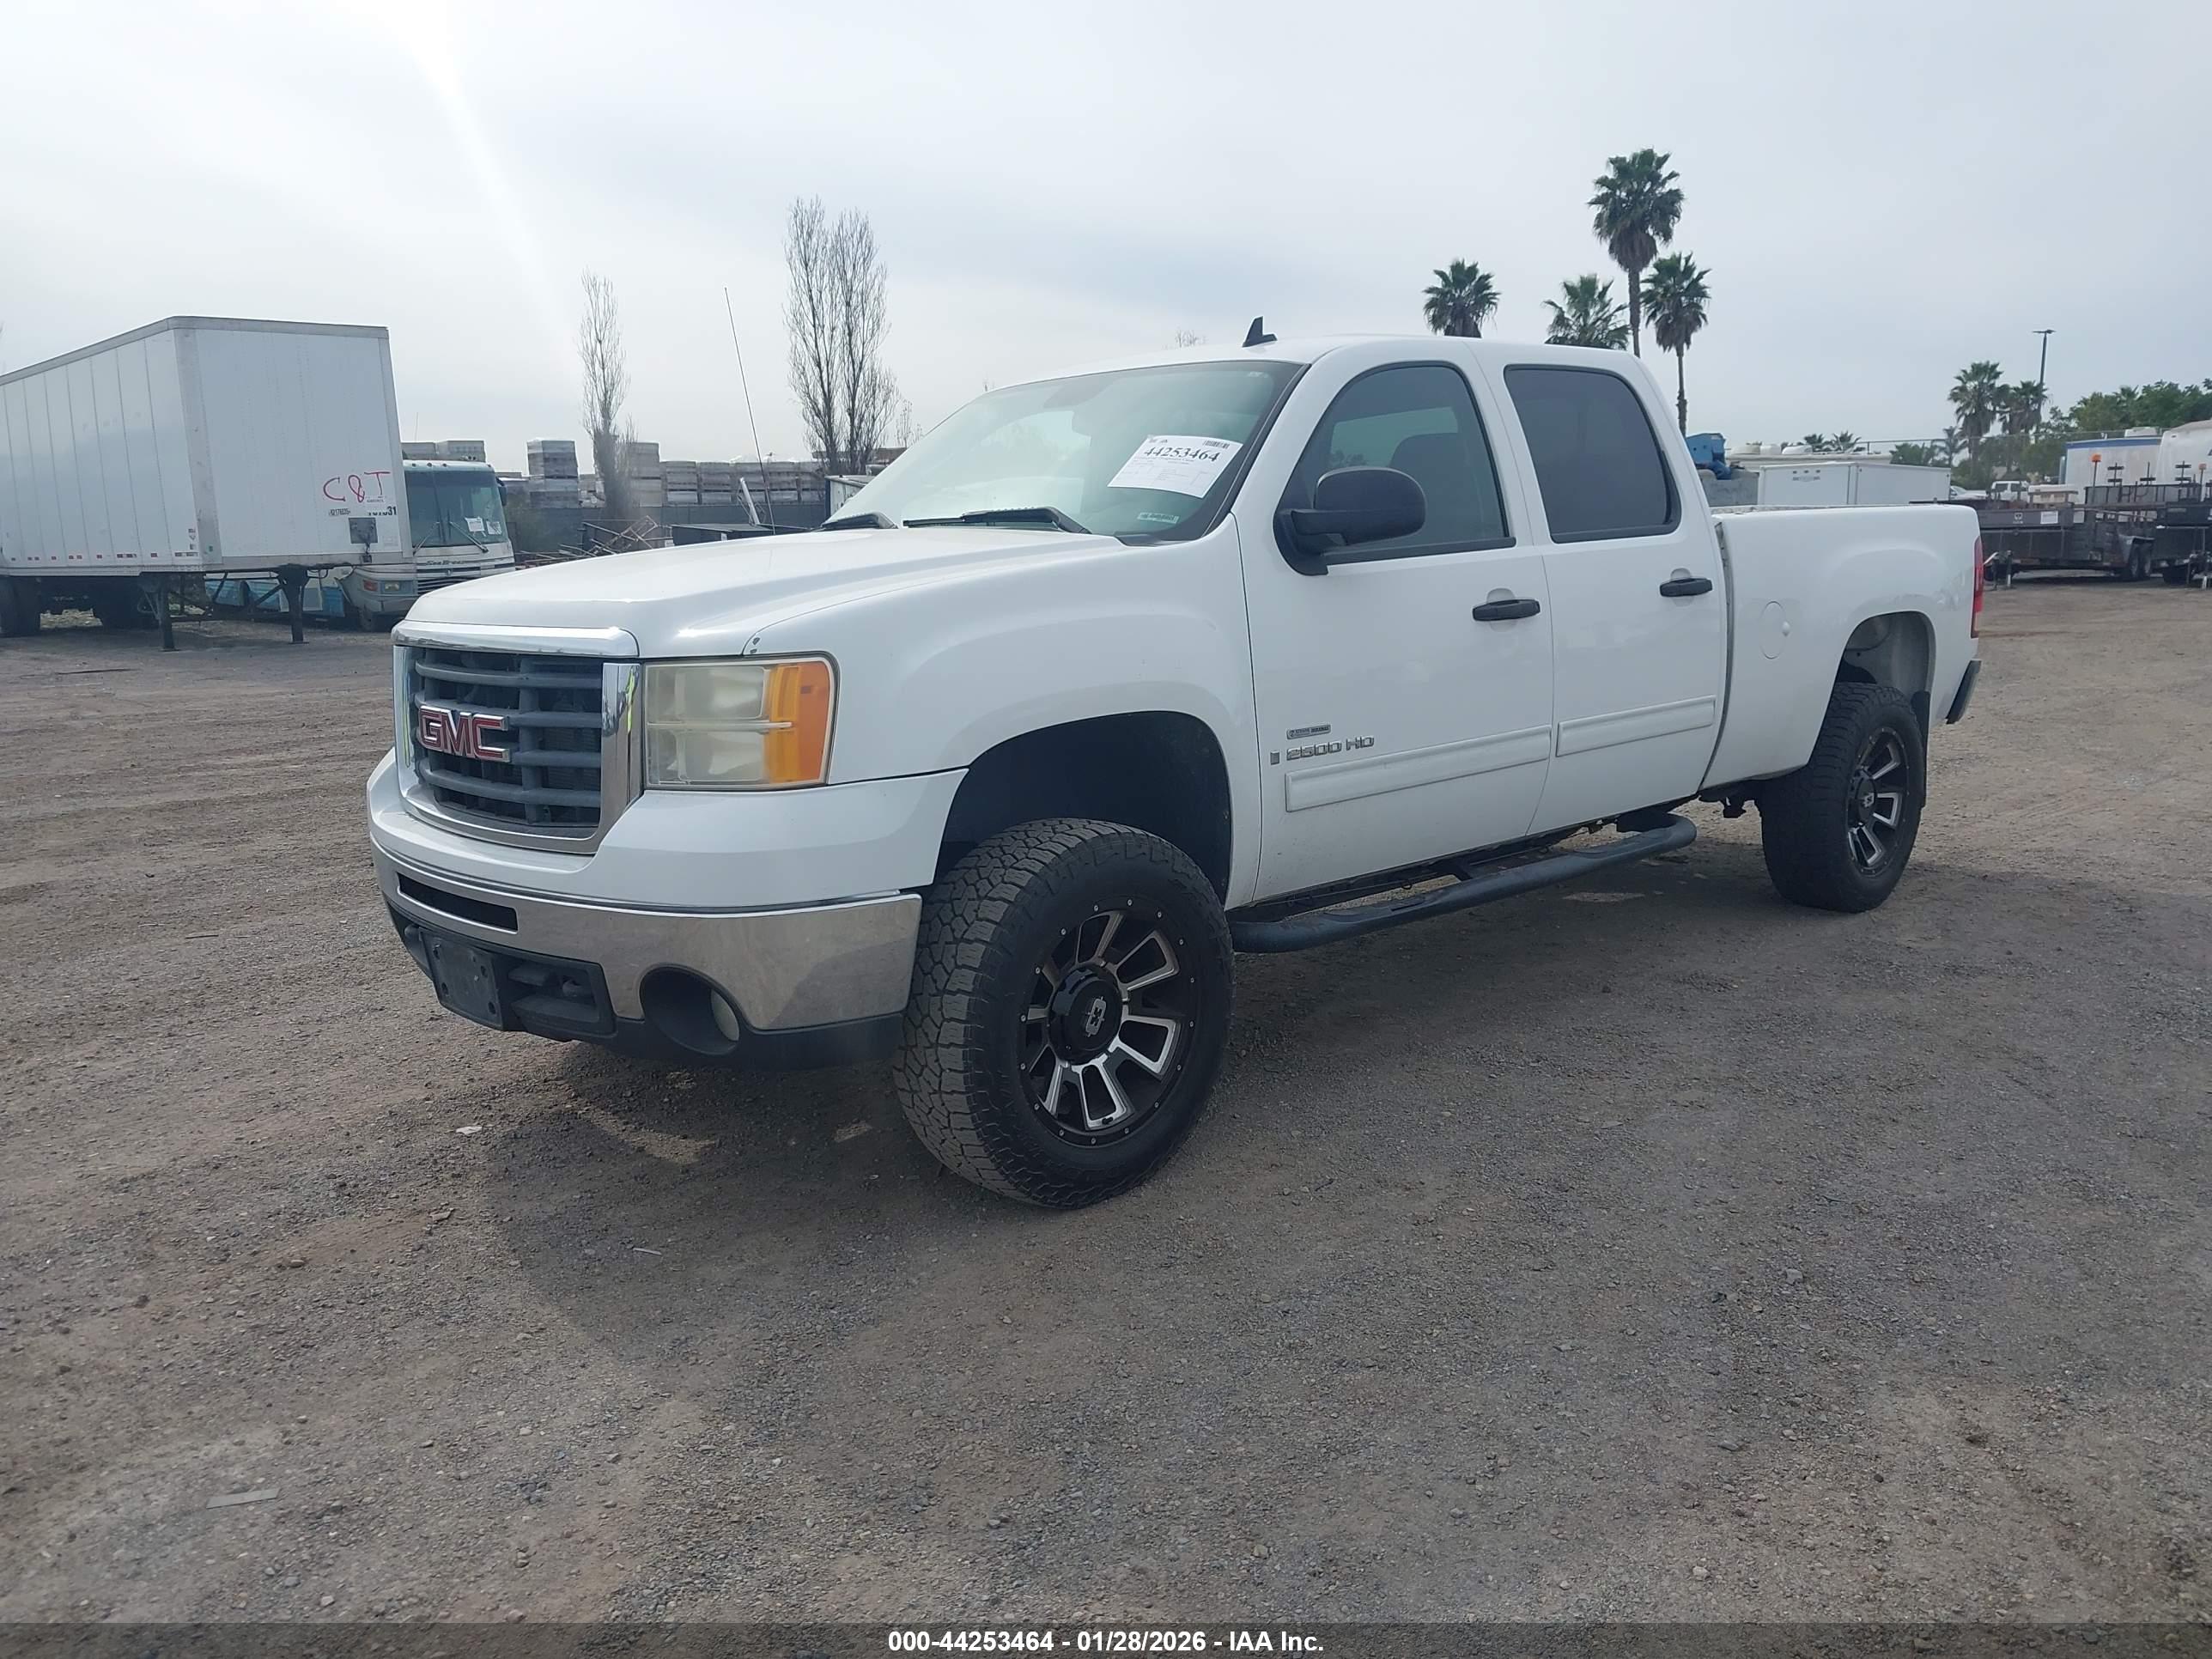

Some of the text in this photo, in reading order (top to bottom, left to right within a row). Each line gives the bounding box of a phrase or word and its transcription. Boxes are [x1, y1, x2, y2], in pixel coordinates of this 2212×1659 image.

[1144, 446, 1221, 463] 44253464
[419, 705, 511, 763] GMC
[1286, 734, 1375, 761] 2500 HD
